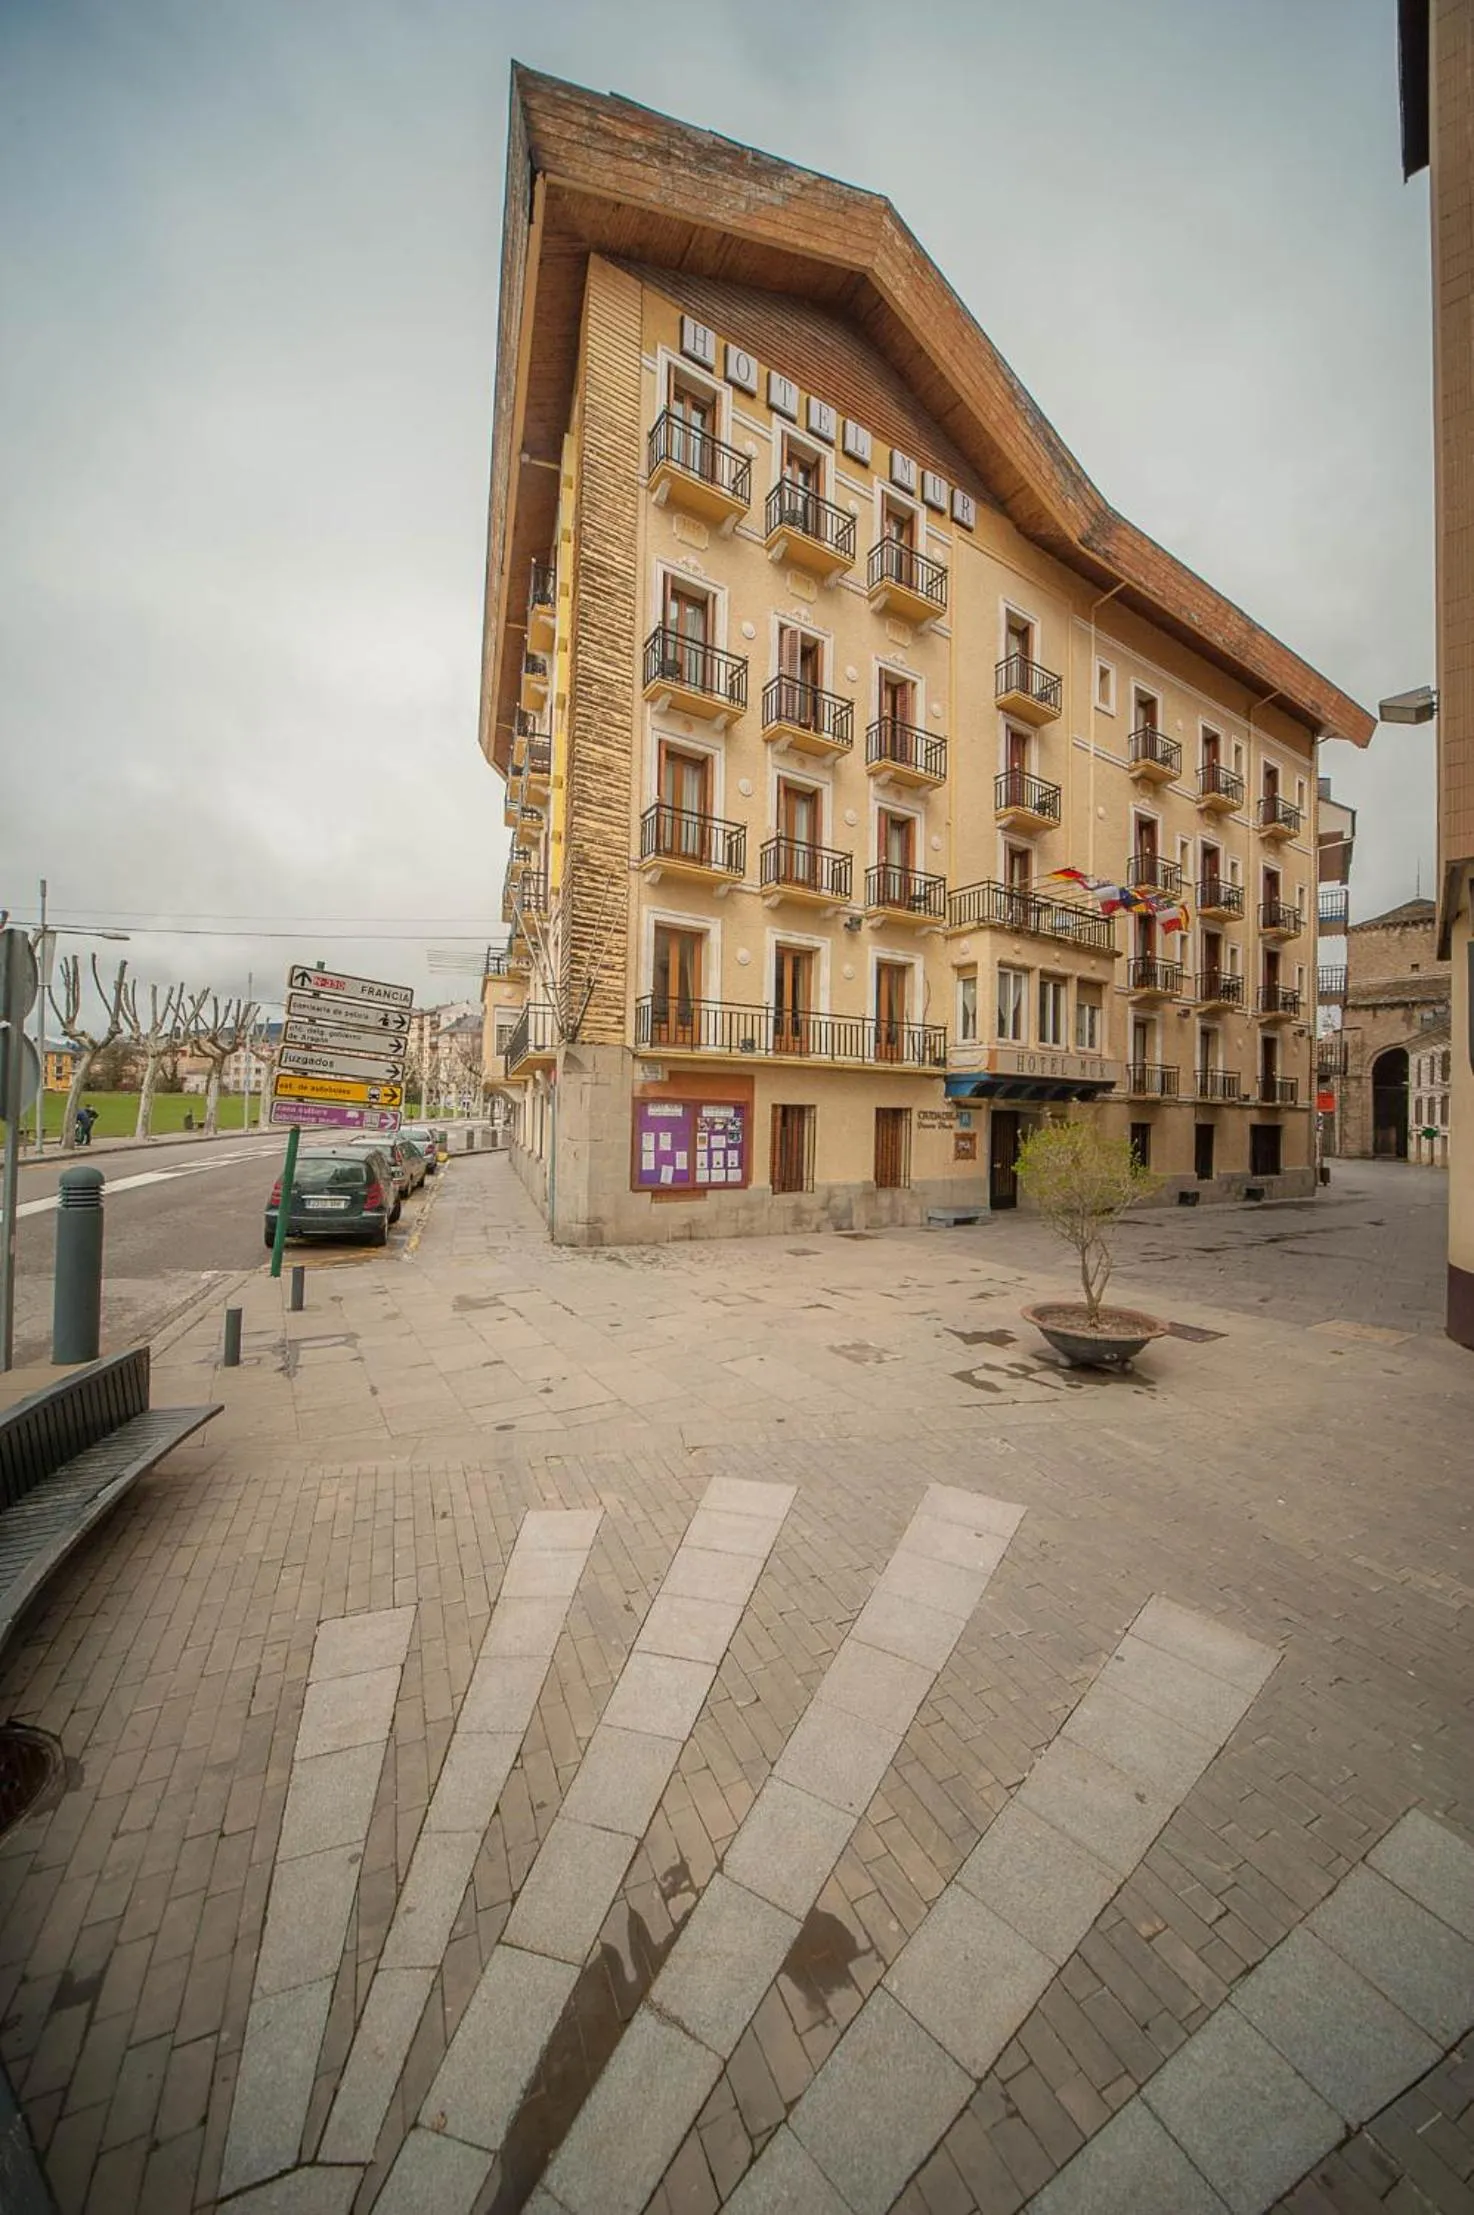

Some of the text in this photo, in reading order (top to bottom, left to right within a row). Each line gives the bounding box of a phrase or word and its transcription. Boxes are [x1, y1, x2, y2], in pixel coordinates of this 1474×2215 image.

[690, 322, 973, 523] HOTEL MUR
[361, 985, 410, 1002] FRANCIA
[333, 1007, 343, 1016] de
[287, 1032, 299, 1041] de
[283, 1052, 335, 1068] juzgados
[1016, 1054, 1107, 1078] HOTEL MUR
[299, 1081, 309, 1090] de
